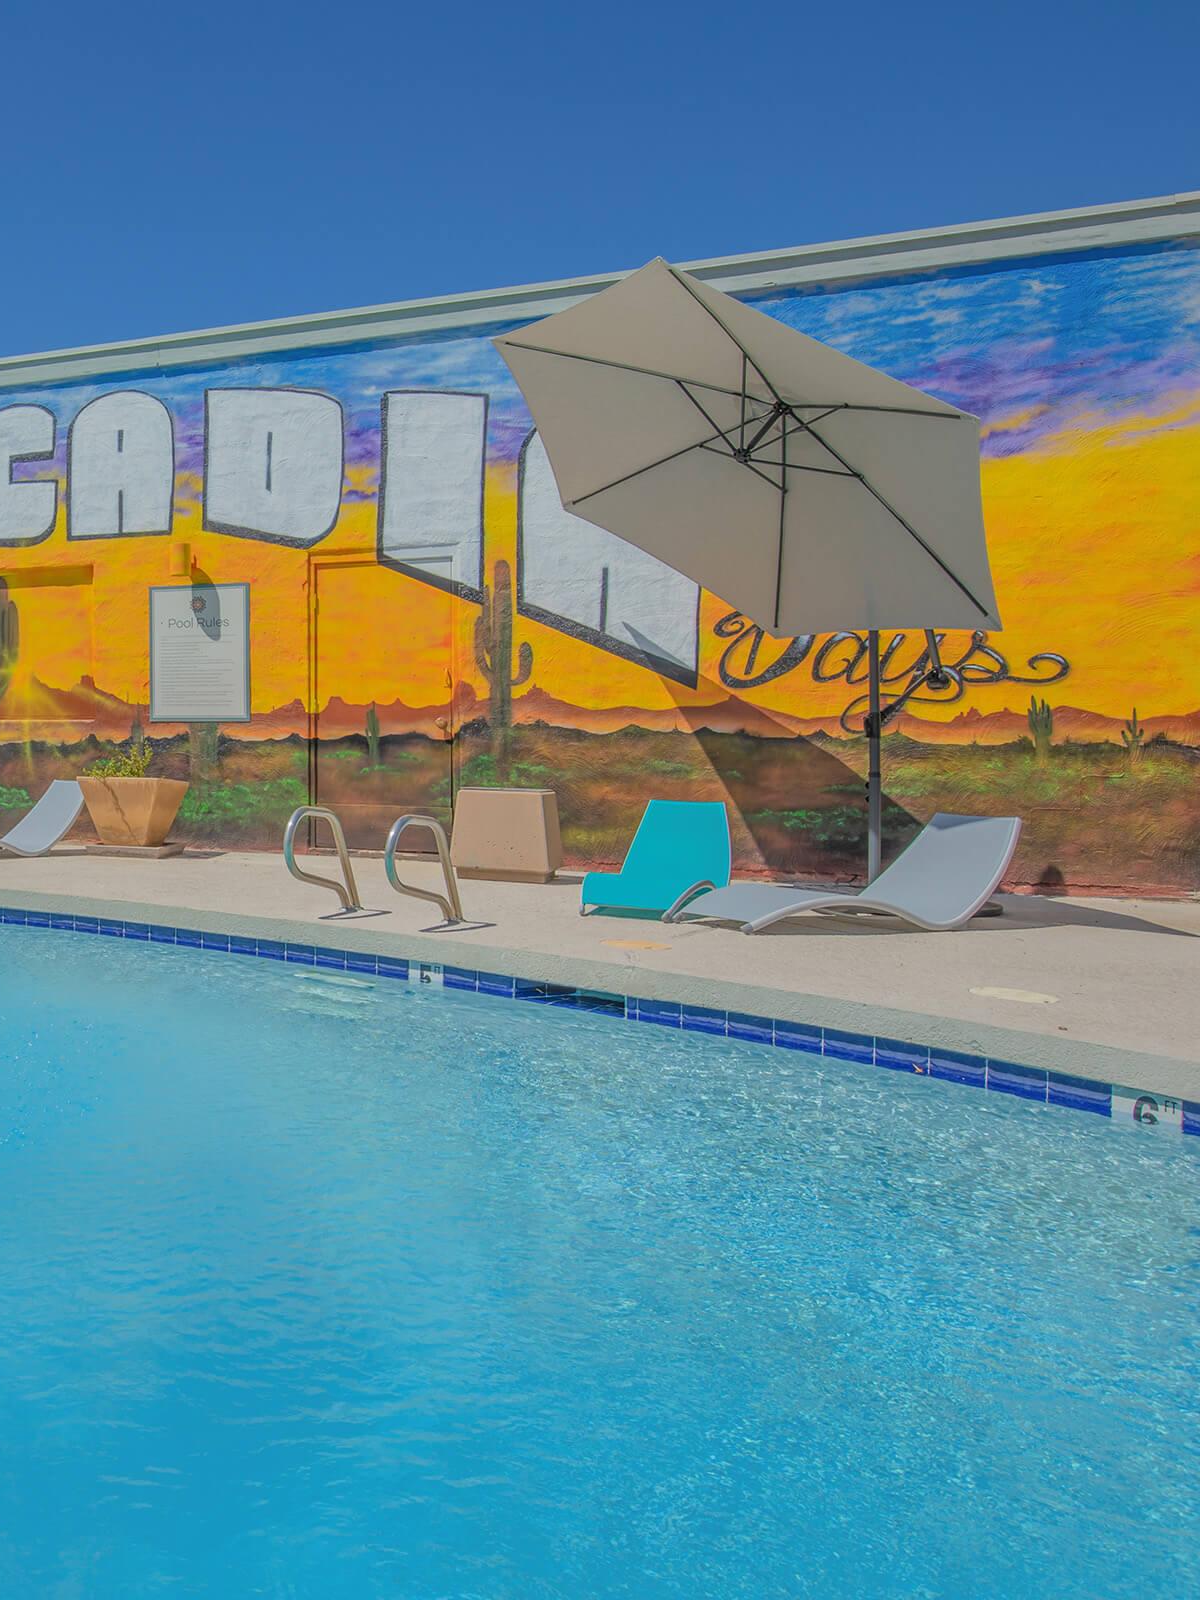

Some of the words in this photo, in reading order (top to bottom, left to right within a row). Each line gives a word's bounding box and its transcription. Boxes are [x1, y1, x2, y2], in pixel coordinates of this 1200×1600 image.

[168, 617, 193, 629] Pool
[197, 616, 230, 628] Rules
[713, 611, 1070, 734] Days
[419, 964, 431, 984] 5
[1133, 1095, 1159, 1125] 6
[1164, 1100, 1178, 1114] FT
